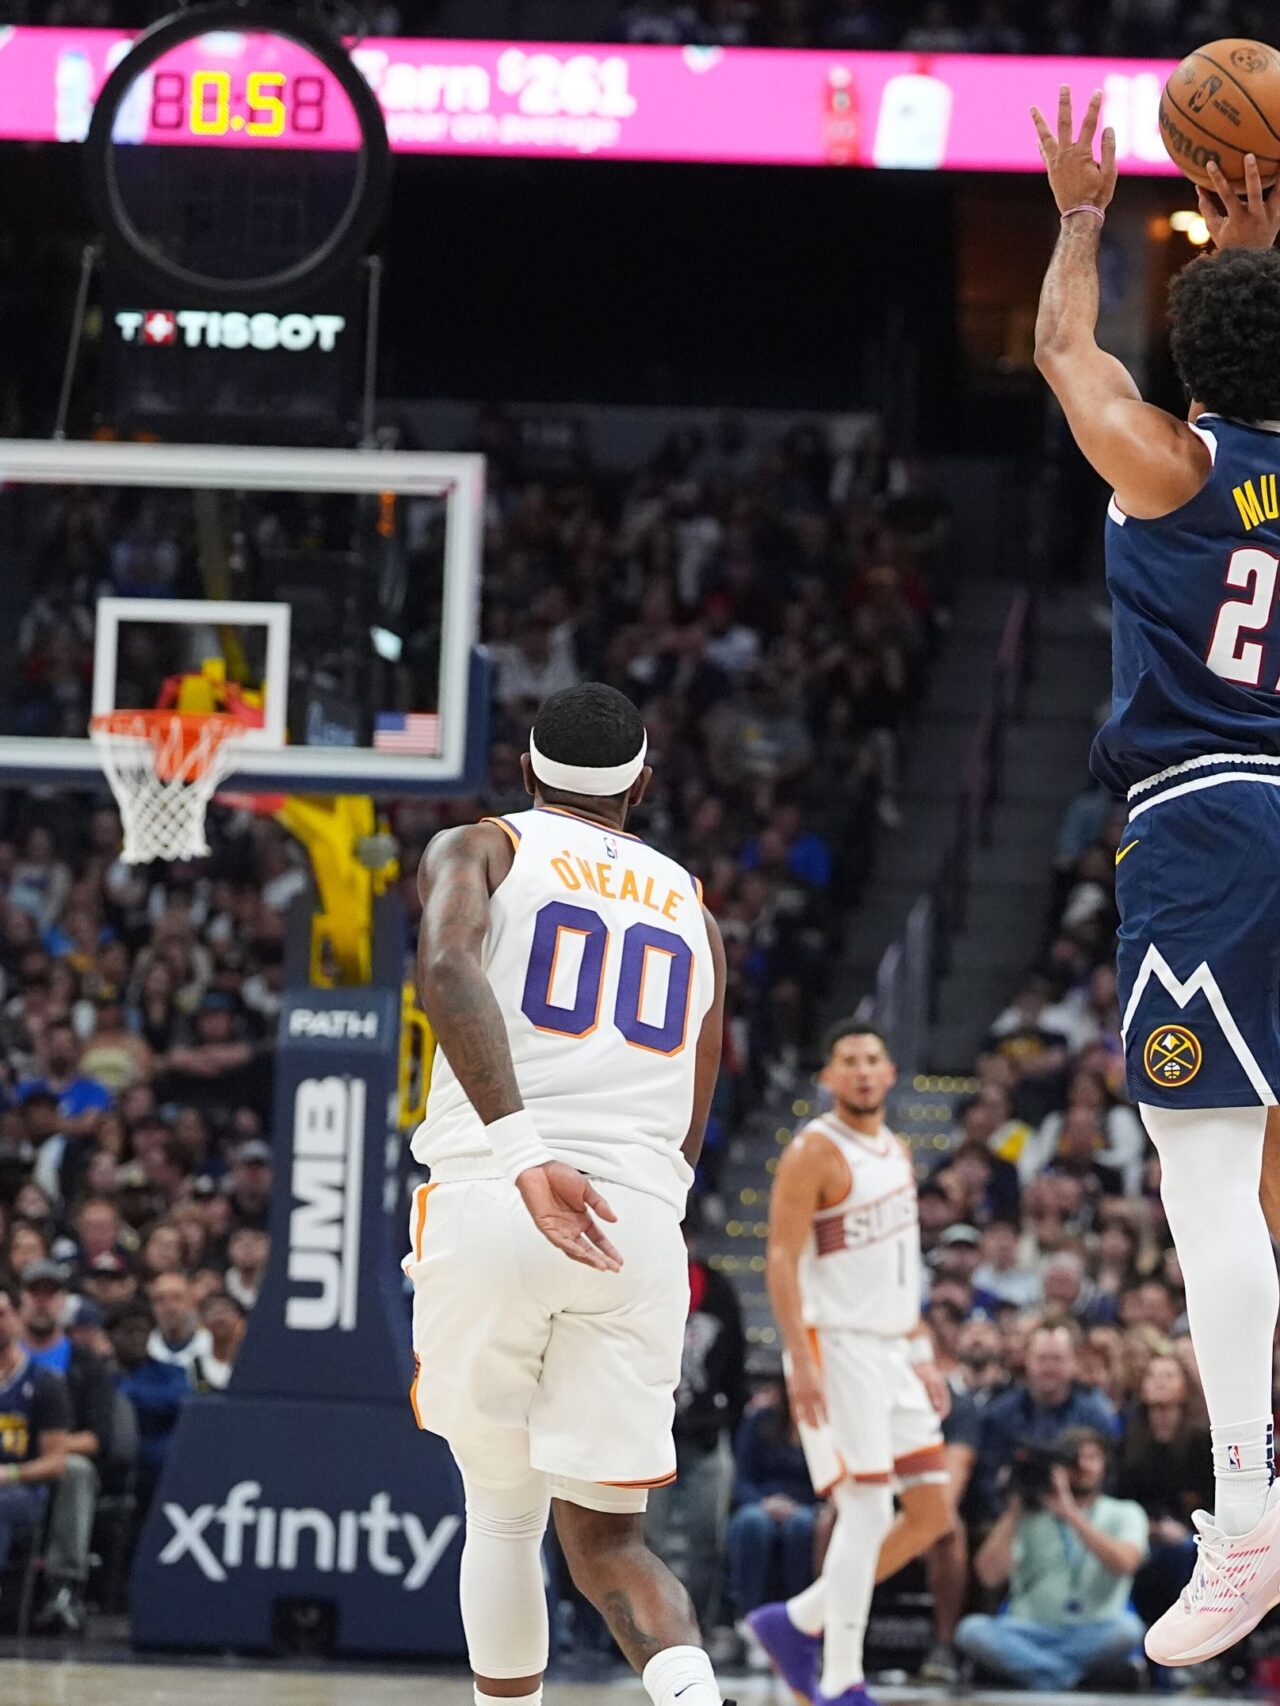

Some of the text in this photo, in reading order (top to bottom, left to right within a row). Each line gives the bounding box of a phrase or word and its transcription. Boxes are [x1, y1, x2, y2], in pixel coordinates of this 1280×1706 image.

[176, 310, 346, 352] TISSOT
[550, 849, 685, 922] O'NEALE
[289, 1008, 379, 1039] PATH
[520, 900, 695, 1058] 00
[286, 1075, 348, 1331] UMB
[158, 1480, 461, 1591] xfinity
